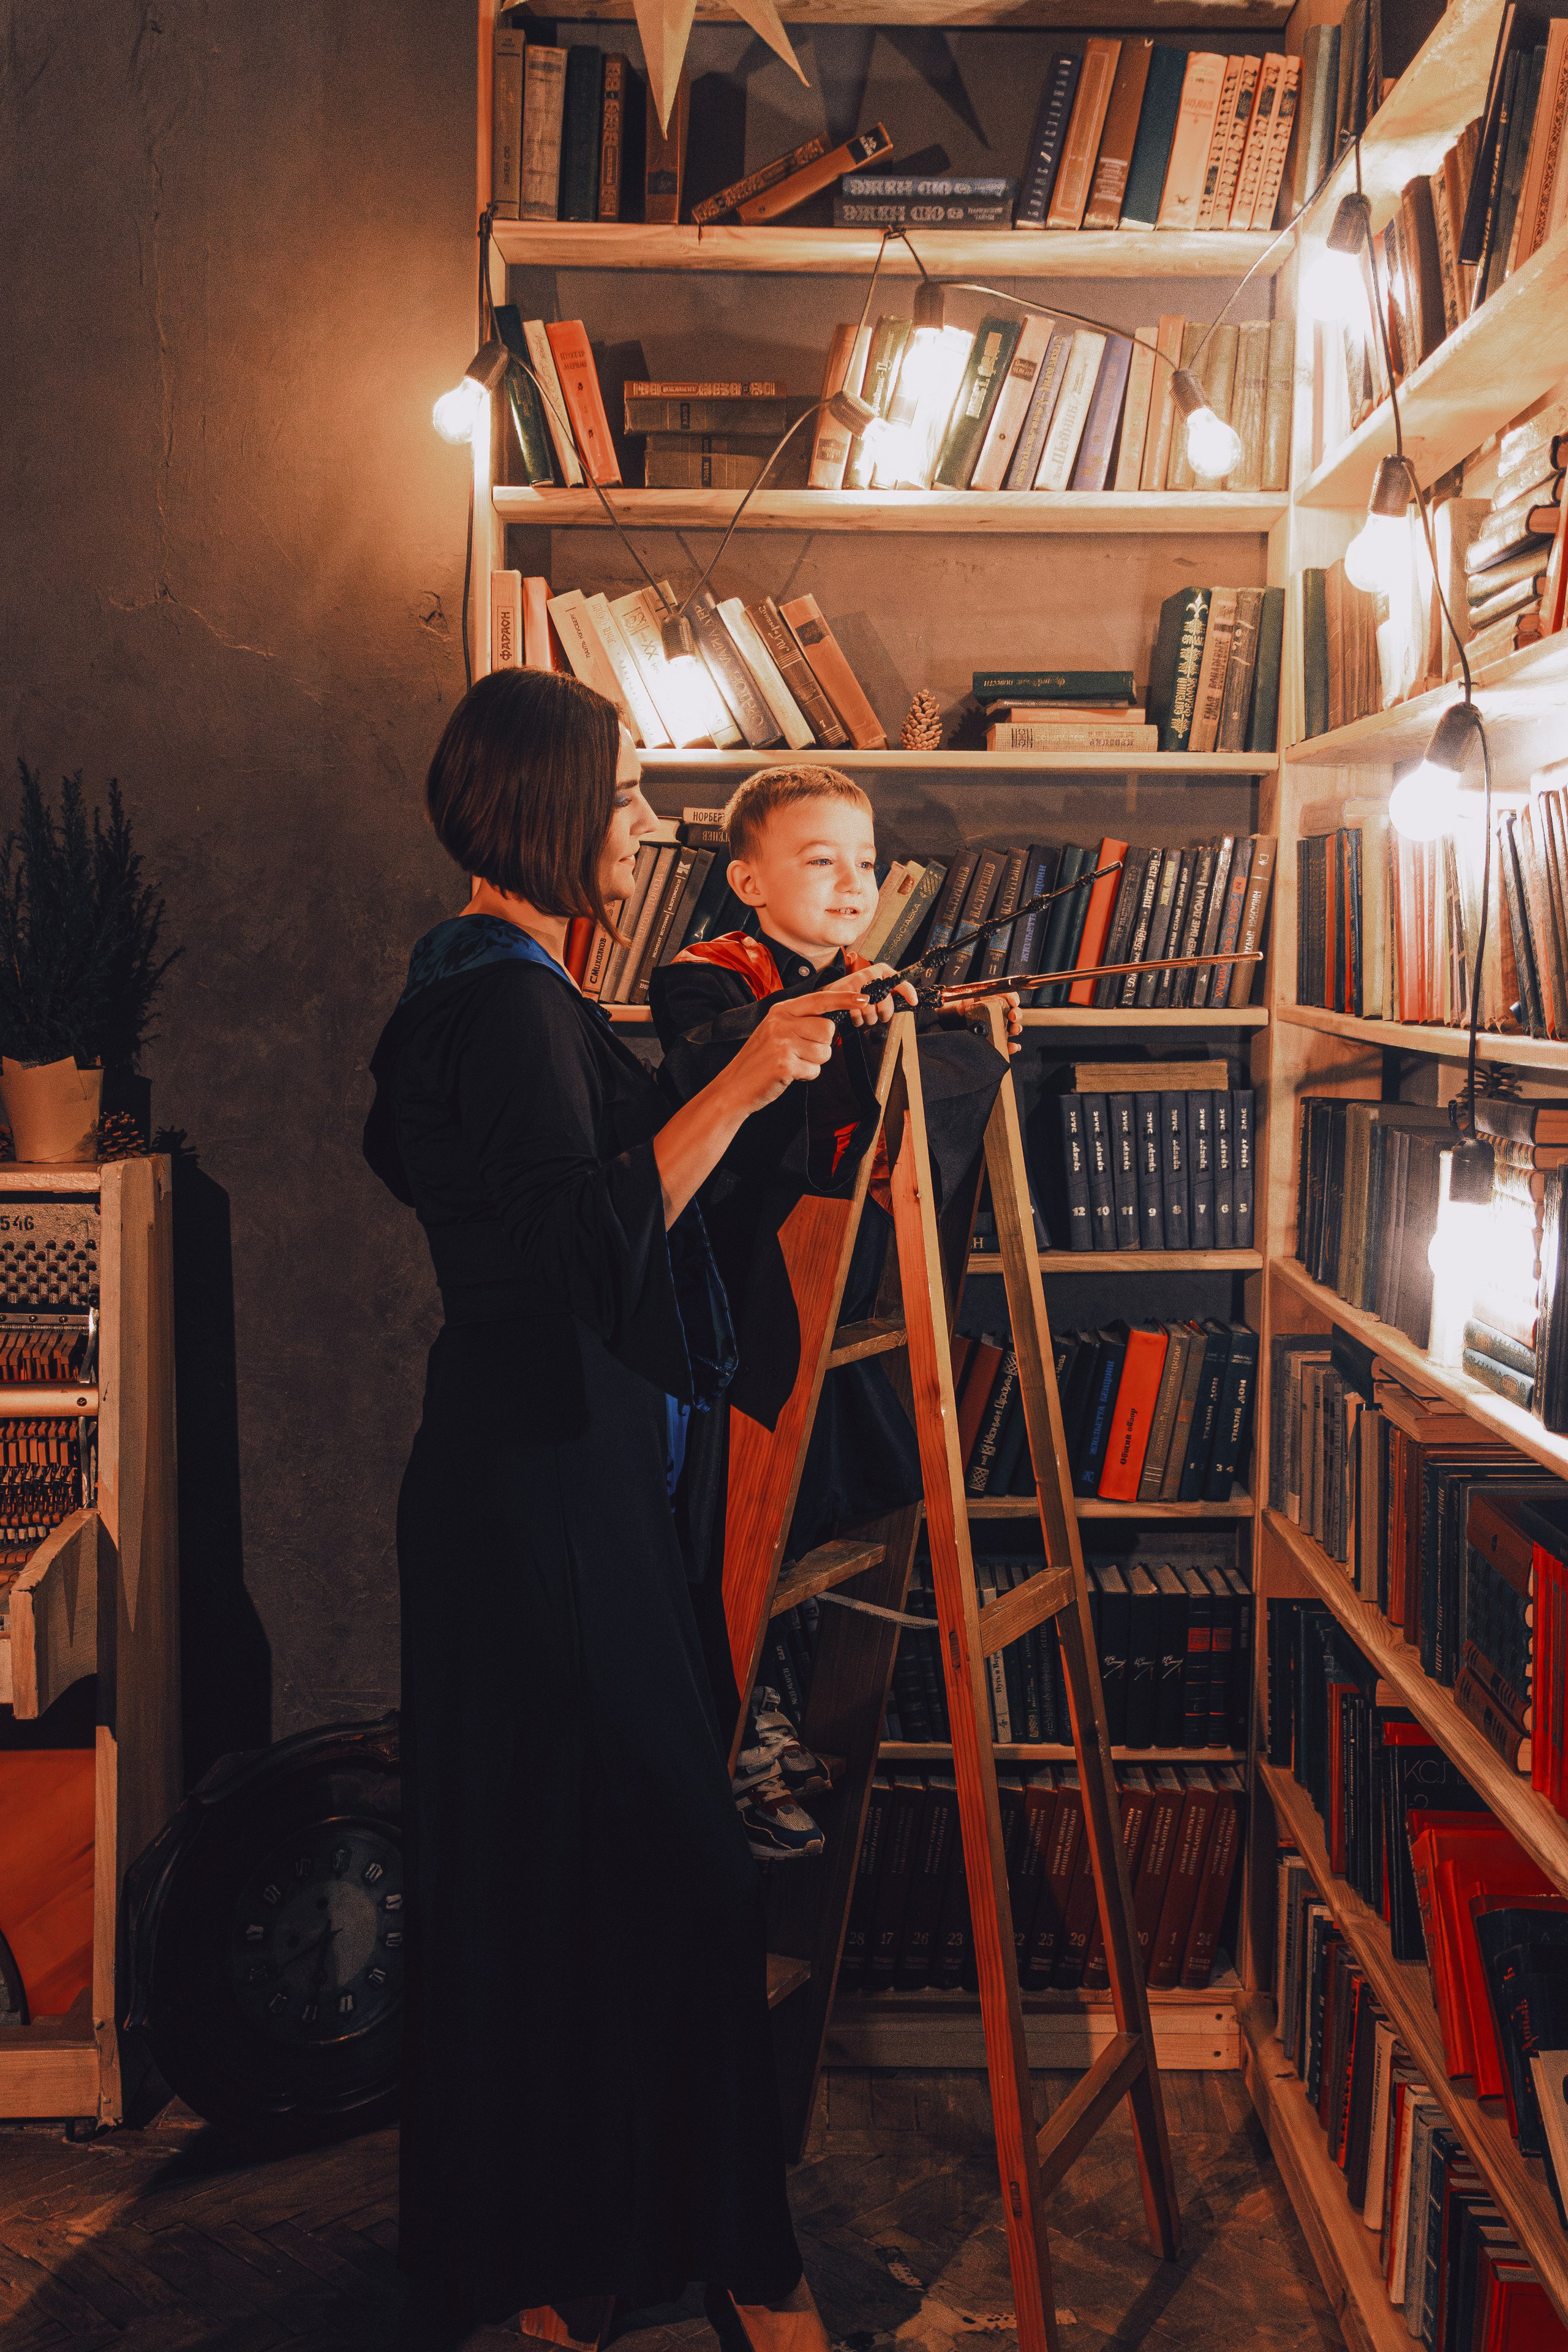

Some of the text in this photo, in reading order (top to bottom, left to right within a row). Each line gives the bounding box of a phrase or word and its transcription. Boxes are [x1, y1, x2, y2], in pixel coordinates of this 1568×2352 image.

[500, 611, 513, 661] ФАРАОН
[582, 641, 590, 658] ПАУЛЬ
[1143, 878, 1155, 908] ПИТЕР
[1150, 860, 1159, 877] ПЭН
[1186, 937, 1196, 958] ЕЧЕР
[1194, 888, 1207, 918] ДОМА
[652, 914, 670, 958] МОМЕНТ ИСТИНЫ
[1020, 913, 1037, 962] ЖЮЛЬЕТТ
[1243, 930, 1256, 954] ХАИЛ
[1215, 899, 1240, 998] САГА О ФОАЙТАХ
[590, 937, 608, 985] С.Михалков
[925, 968, 933, 978] 6
[953, 965, 962, 976] 7
[989, 964, 997, 975] 11
[1199, 974, 1207, 984] 4
[1072, 1206, 1085, 1216] 12
[1096, 1206, 1110, 1216] 10
[1121, 1206, 1134, 1216] 11
[1148, 1208, 1156, 1217] 9
[1172, 1205, 1182, 1215] 8
[1198, 1204, 1206, 1214] 7
[1221, 1204, 1229, 1213] 6
[1238, 1203, 1247, 1213] 5
[1090, 1360, 1115, 1456] ЖЮЛЬЕТТА БЕНЦОНИ
[1120, 1408, 1138, 1465] Общий обзор
[1038, 1932, 1054, 1947] 25
[1069, 1931, 1087, 1947] 29
[1170, 1931, 1178, 1945] 1
